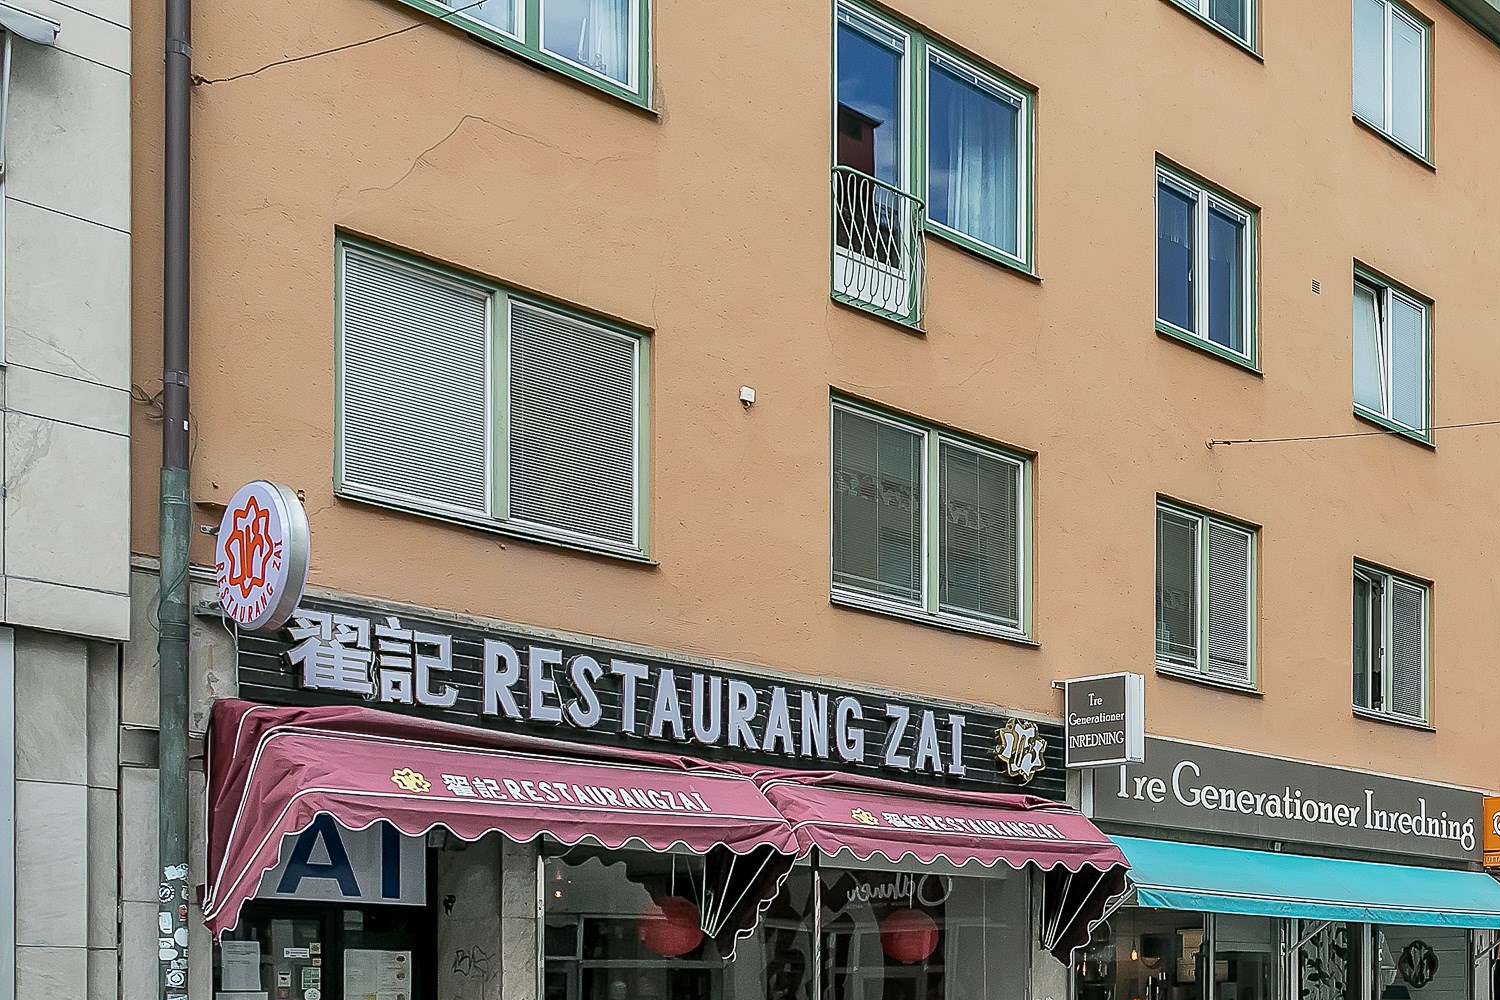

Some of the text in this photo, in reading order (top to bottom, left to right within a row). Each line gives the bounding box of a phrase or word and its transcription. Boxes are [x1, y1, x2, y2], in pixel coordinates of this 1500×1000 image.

[272, 540, 283, 572] ZAI
[215, 561, 275, 623] RESTAURANG
[482, 638, 967, 776] RESTAURANG ZAI
[1088, 692, 1104, 707] Tre
[1068, 712, 1126, 726] Generationer
[1069, 731, 1125, 749] INREDNING
[1171, 760, 1361, 828] Generationer
[1363, 789, 1476, 851] Inredning
